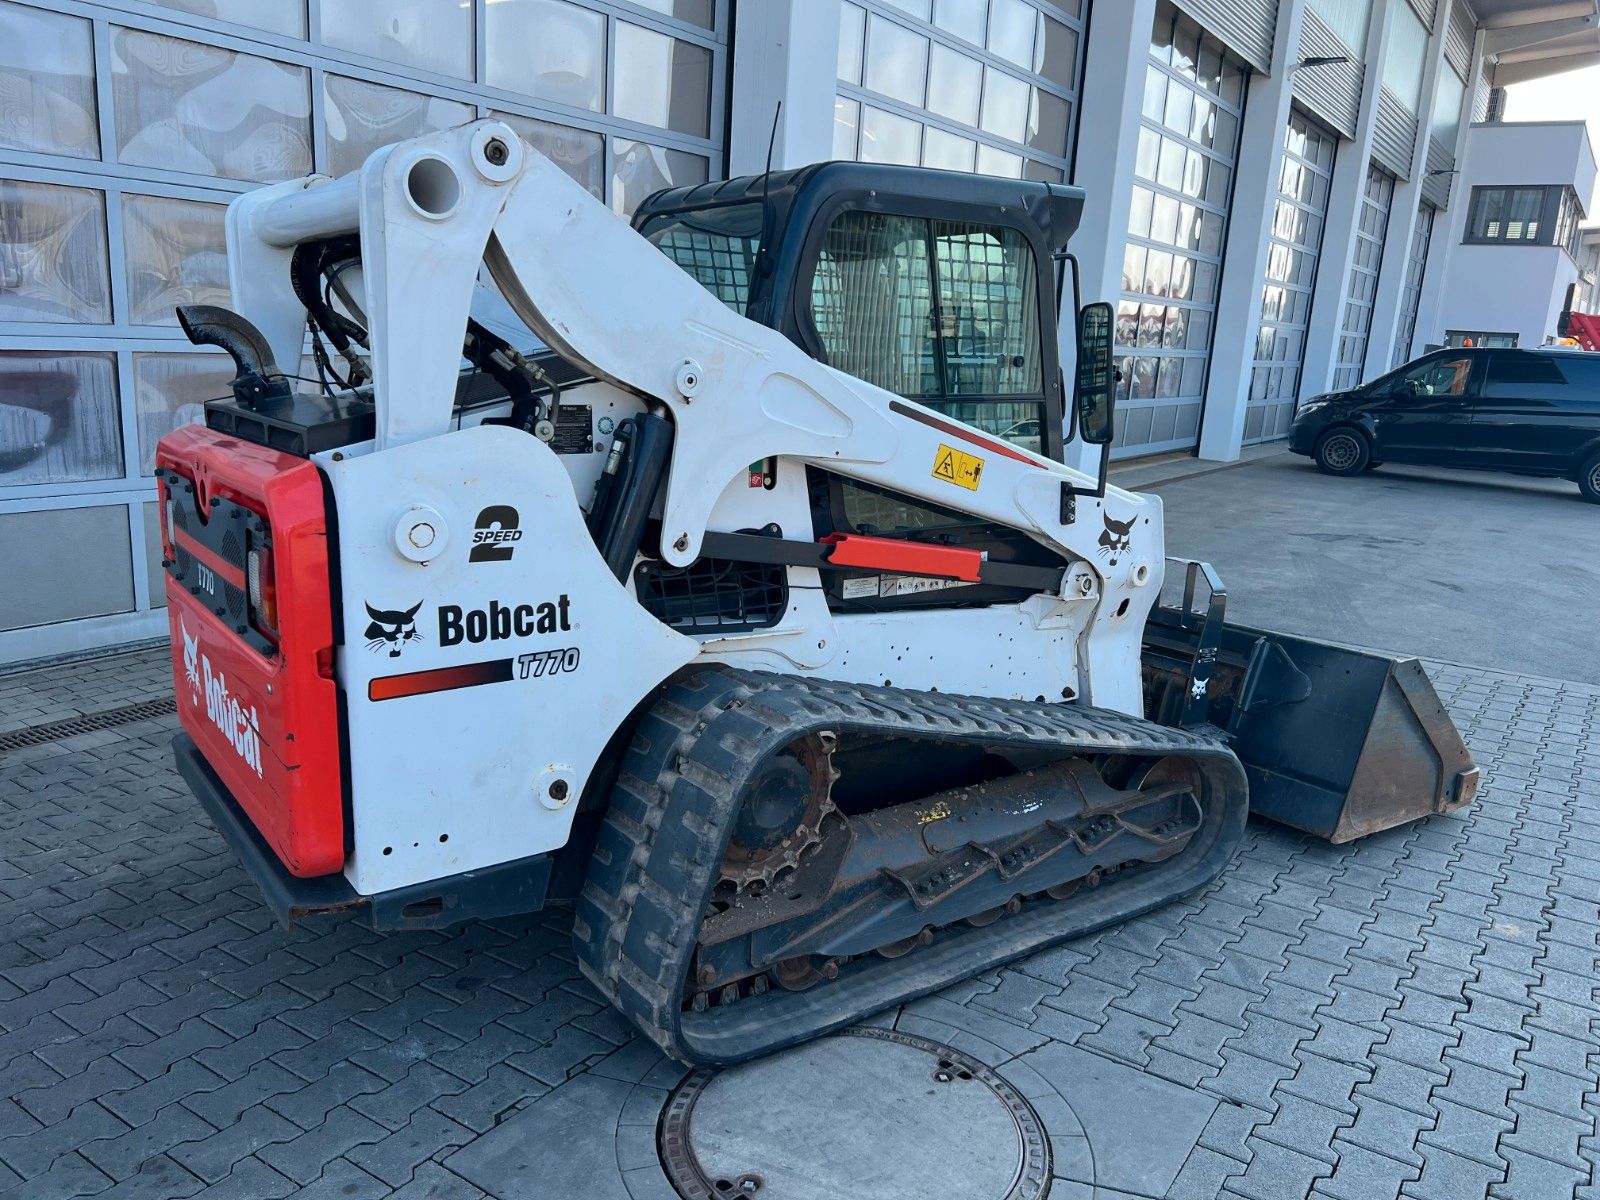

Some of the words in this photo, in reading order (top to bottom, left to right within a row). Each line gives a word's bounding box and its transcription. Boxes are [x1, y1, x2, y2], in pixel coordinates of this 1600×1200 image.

[468, 504, 520, 563] 2
[472, 529, 523, 543] SPEED
[197, 562, 214, 595] T770
[438, 594, 571, 647] Bobcat
[518, 647, 580, 679] T770
